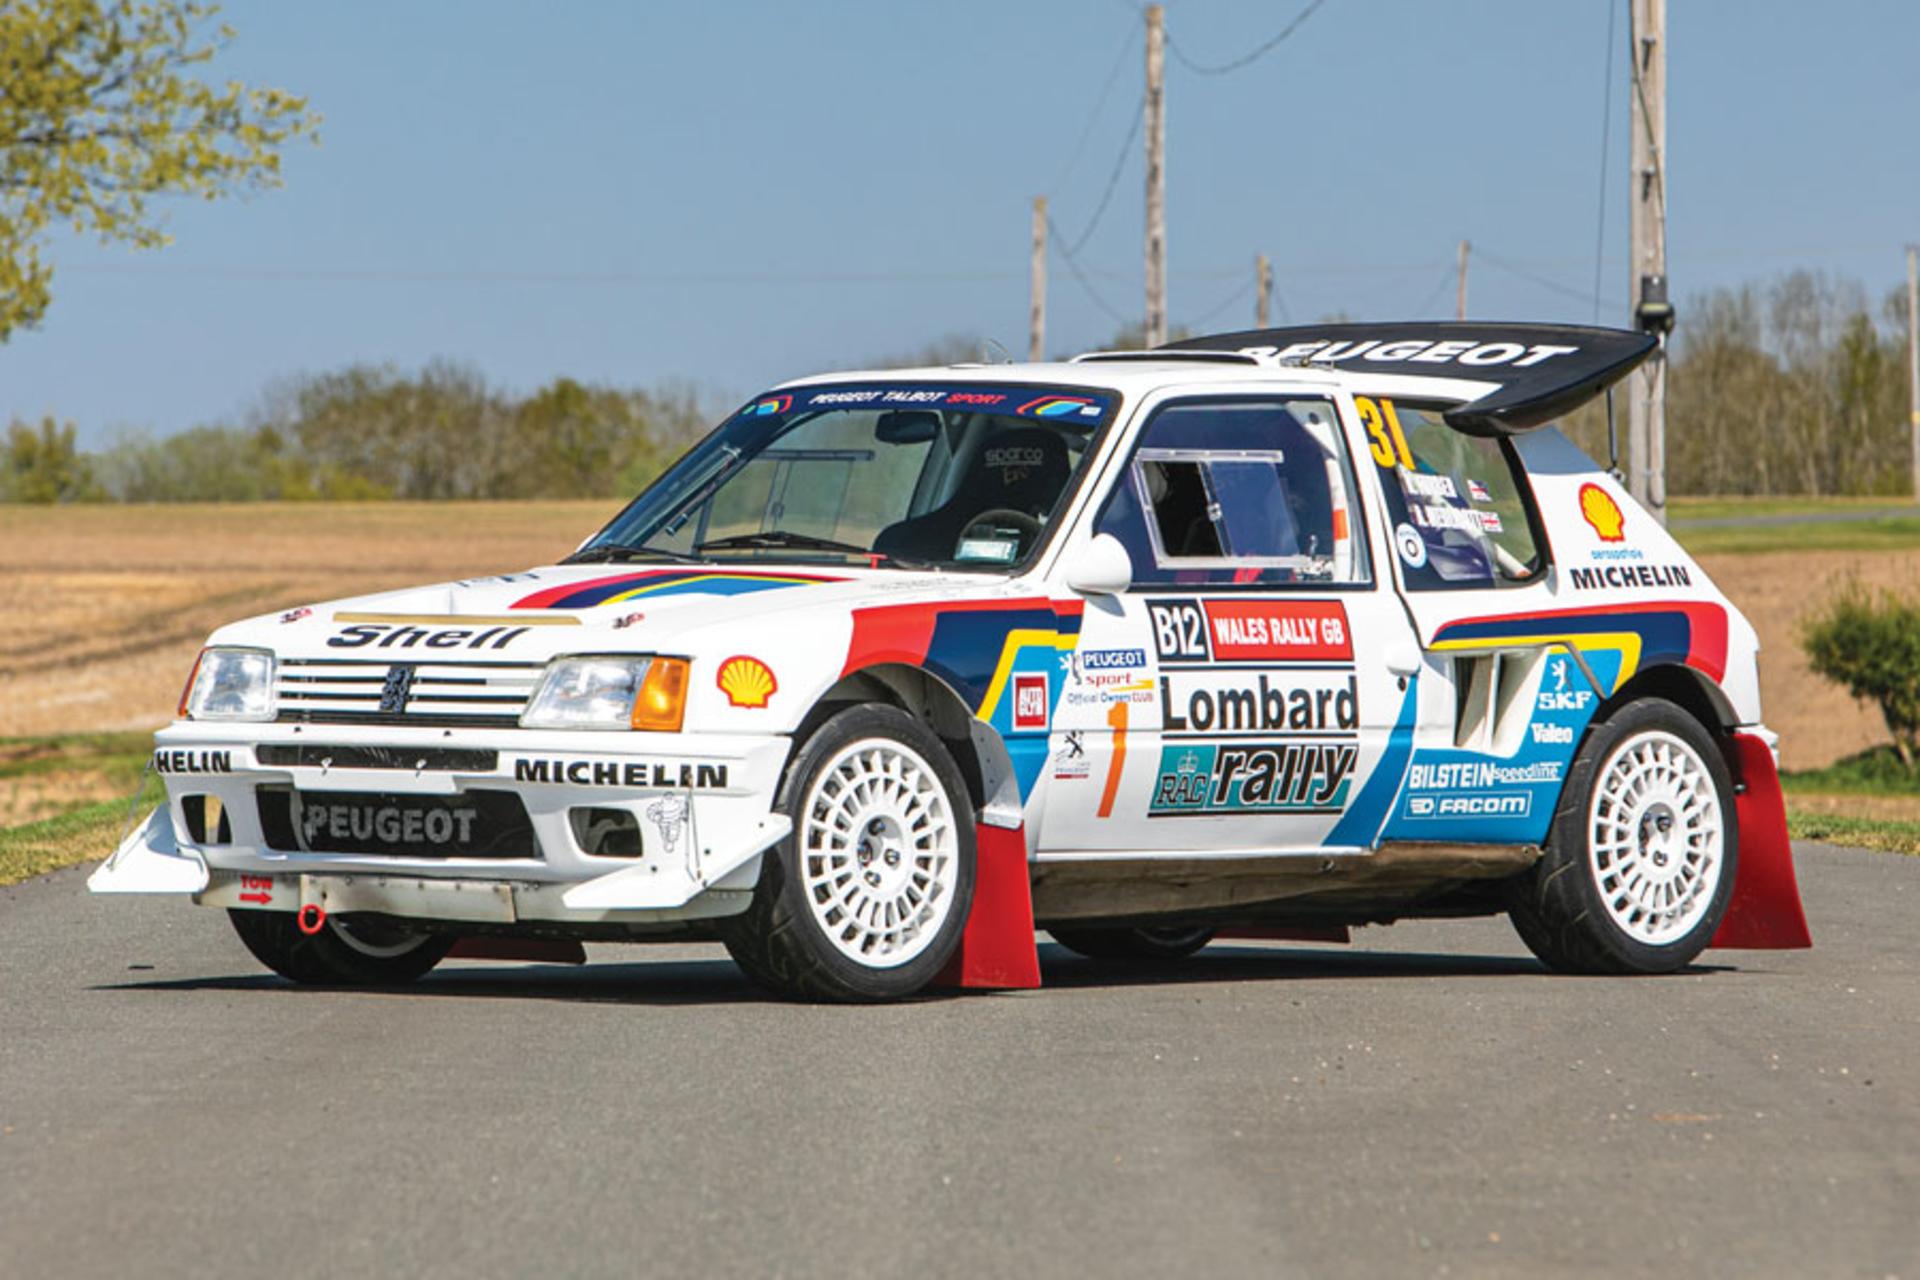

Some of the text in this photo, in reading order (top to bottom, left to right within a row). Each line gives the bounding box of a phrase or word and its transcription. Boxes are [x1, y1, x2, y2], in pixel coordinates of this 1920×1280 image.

[808, 391, 1007, 404] PEUGEOT TALBOT SPORT
[1356, 396, 1416, 469] 31
[1570, 565, 1692, 590] MICHELIN
[327, 625, 532, 650] Shell
[1152, 606, 1205, 655] B12
[1214, 617, 1345, 646] WALES RALLY GB
[1084, 651, 1144, 667] PEUGEOT
[1160, 674, 1360, 731] Lombard
[1538, 691, 1593, 710] SKF
[1532, 723, 1573, 743] Valeo
[514, 759, 728, 788] MICHELIN
[1213, 746, 1357, 807] rally
[1409, 763, 1493, 788] BILSTEIN
[1156, 775, 1207, 805] RAC
[1439, 797, 1527, 814] FACOM
[303, 804, 477, 843] PEUGEOT
[240, 875, 274, 890] TOW
